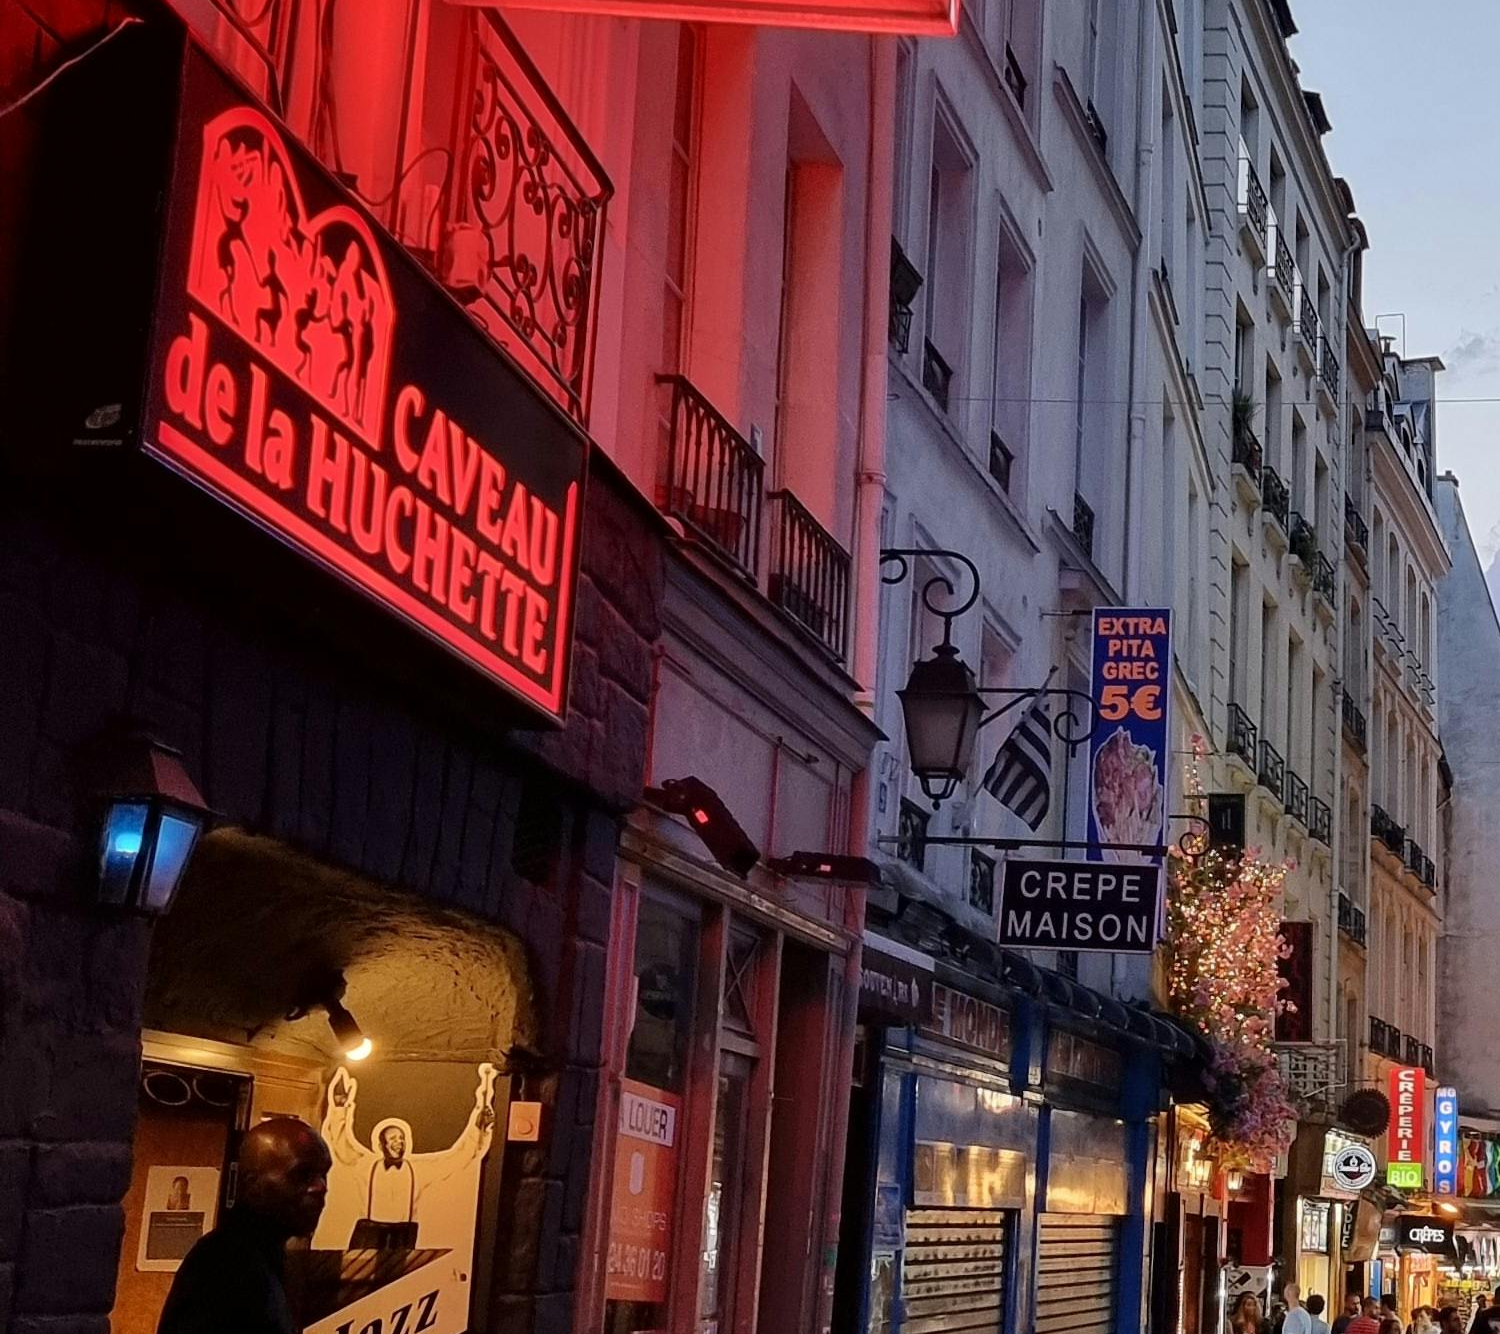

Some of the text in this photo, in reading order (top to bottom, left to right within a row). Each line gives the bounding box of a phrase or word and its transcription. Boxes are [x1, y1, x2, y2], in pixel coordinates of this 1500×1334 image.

[164, 311, 549, 676] de la HUCHETTE
[393, 384, 559, 587] CAVEAU
[1098, 617, 1168, 636] EXTRA
[1107, 639, 1156, 658] PITA
[1102, 661, 1160, 681] GREC
[1098, 684, 1163, 722] 5€
[1020, 870, 1142, 903] CREPE
[1006, 909, 1148, 944] MAISON
[1436, 1087, 1457, 1098] MG
[628, 1097, 669, 1142] LOUER
[1437, 1101, 1453, 1194] GYROS
[1391, 1170, 1418, 1184] BIO
[1409, 1225, 1446, 1244] CRÊPES
